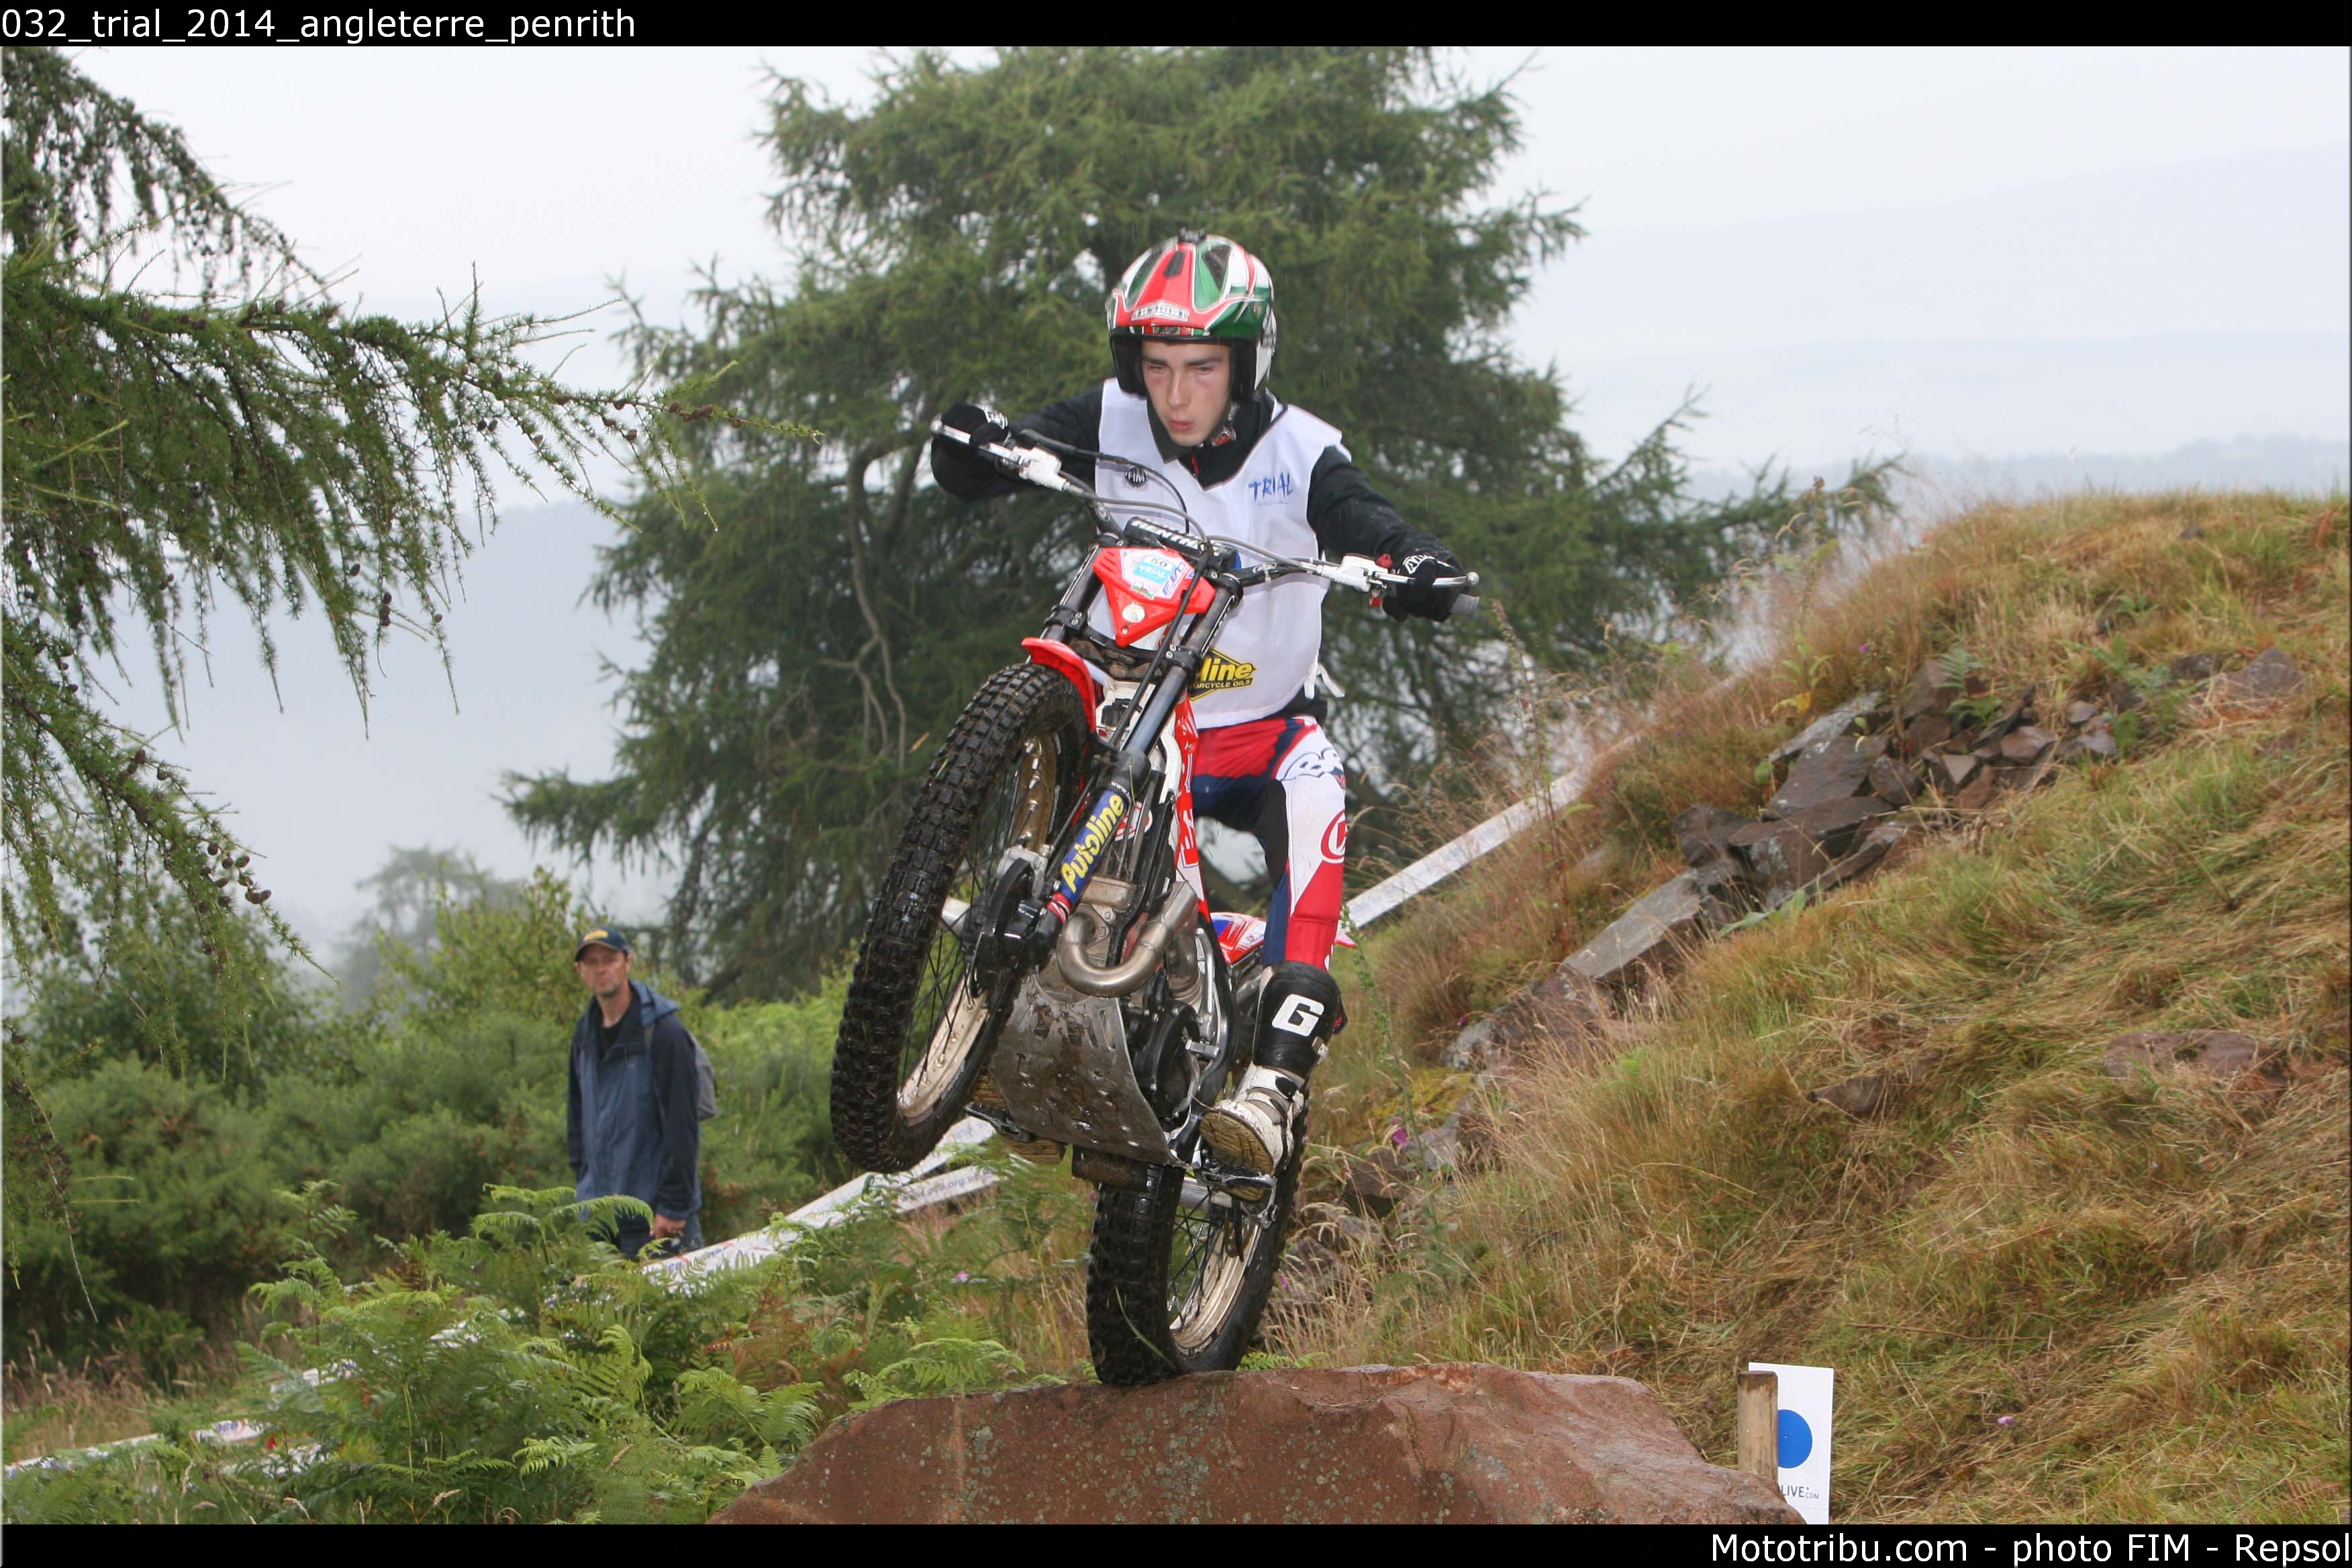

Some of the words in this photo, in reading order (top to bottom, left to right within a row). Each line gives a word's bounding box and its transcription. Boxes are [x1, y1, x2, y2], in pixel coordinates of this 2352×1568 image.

[1248, 472, 1293, 502] TRIAL
[1199, 657, 1253, 681] line
[1061, 795, 1124, 893] Putoline
[1272, 993, 1324, 1036] G
